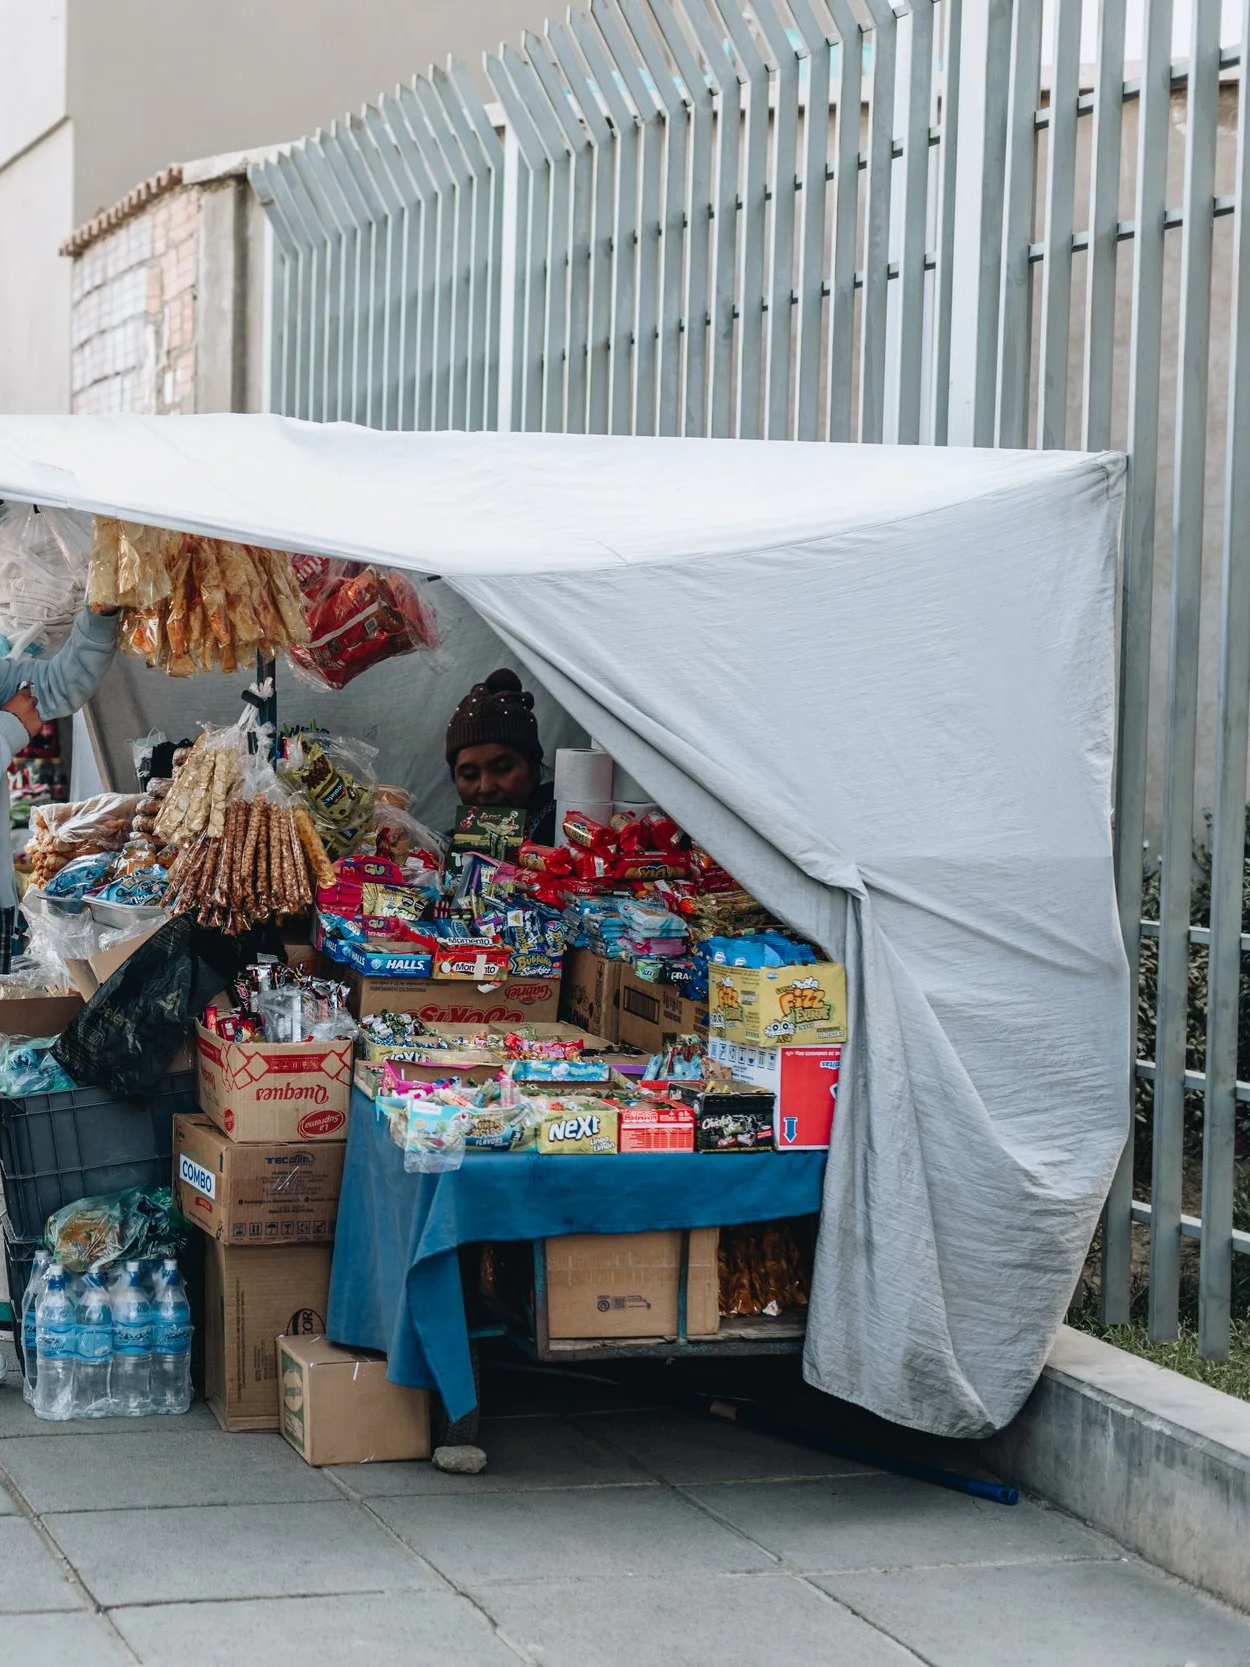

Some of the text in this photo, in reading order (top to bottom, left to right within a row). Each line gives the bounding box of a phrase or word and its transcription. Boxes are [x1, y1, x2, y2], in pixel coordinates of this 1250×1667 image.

[448, 937, 491, 945] Momento
[351, 950, 366, 966] HALLS
[386, 959, 424, 971] HALLS
[505, 984, 549, 998] Gabriel
[255, 1082, 329, 1105] Queques
[304, 1113, 340, 1130] Suprema
[319, 1123, 329, 1132] La
[181, 1159, 213, 1194] COMBO
